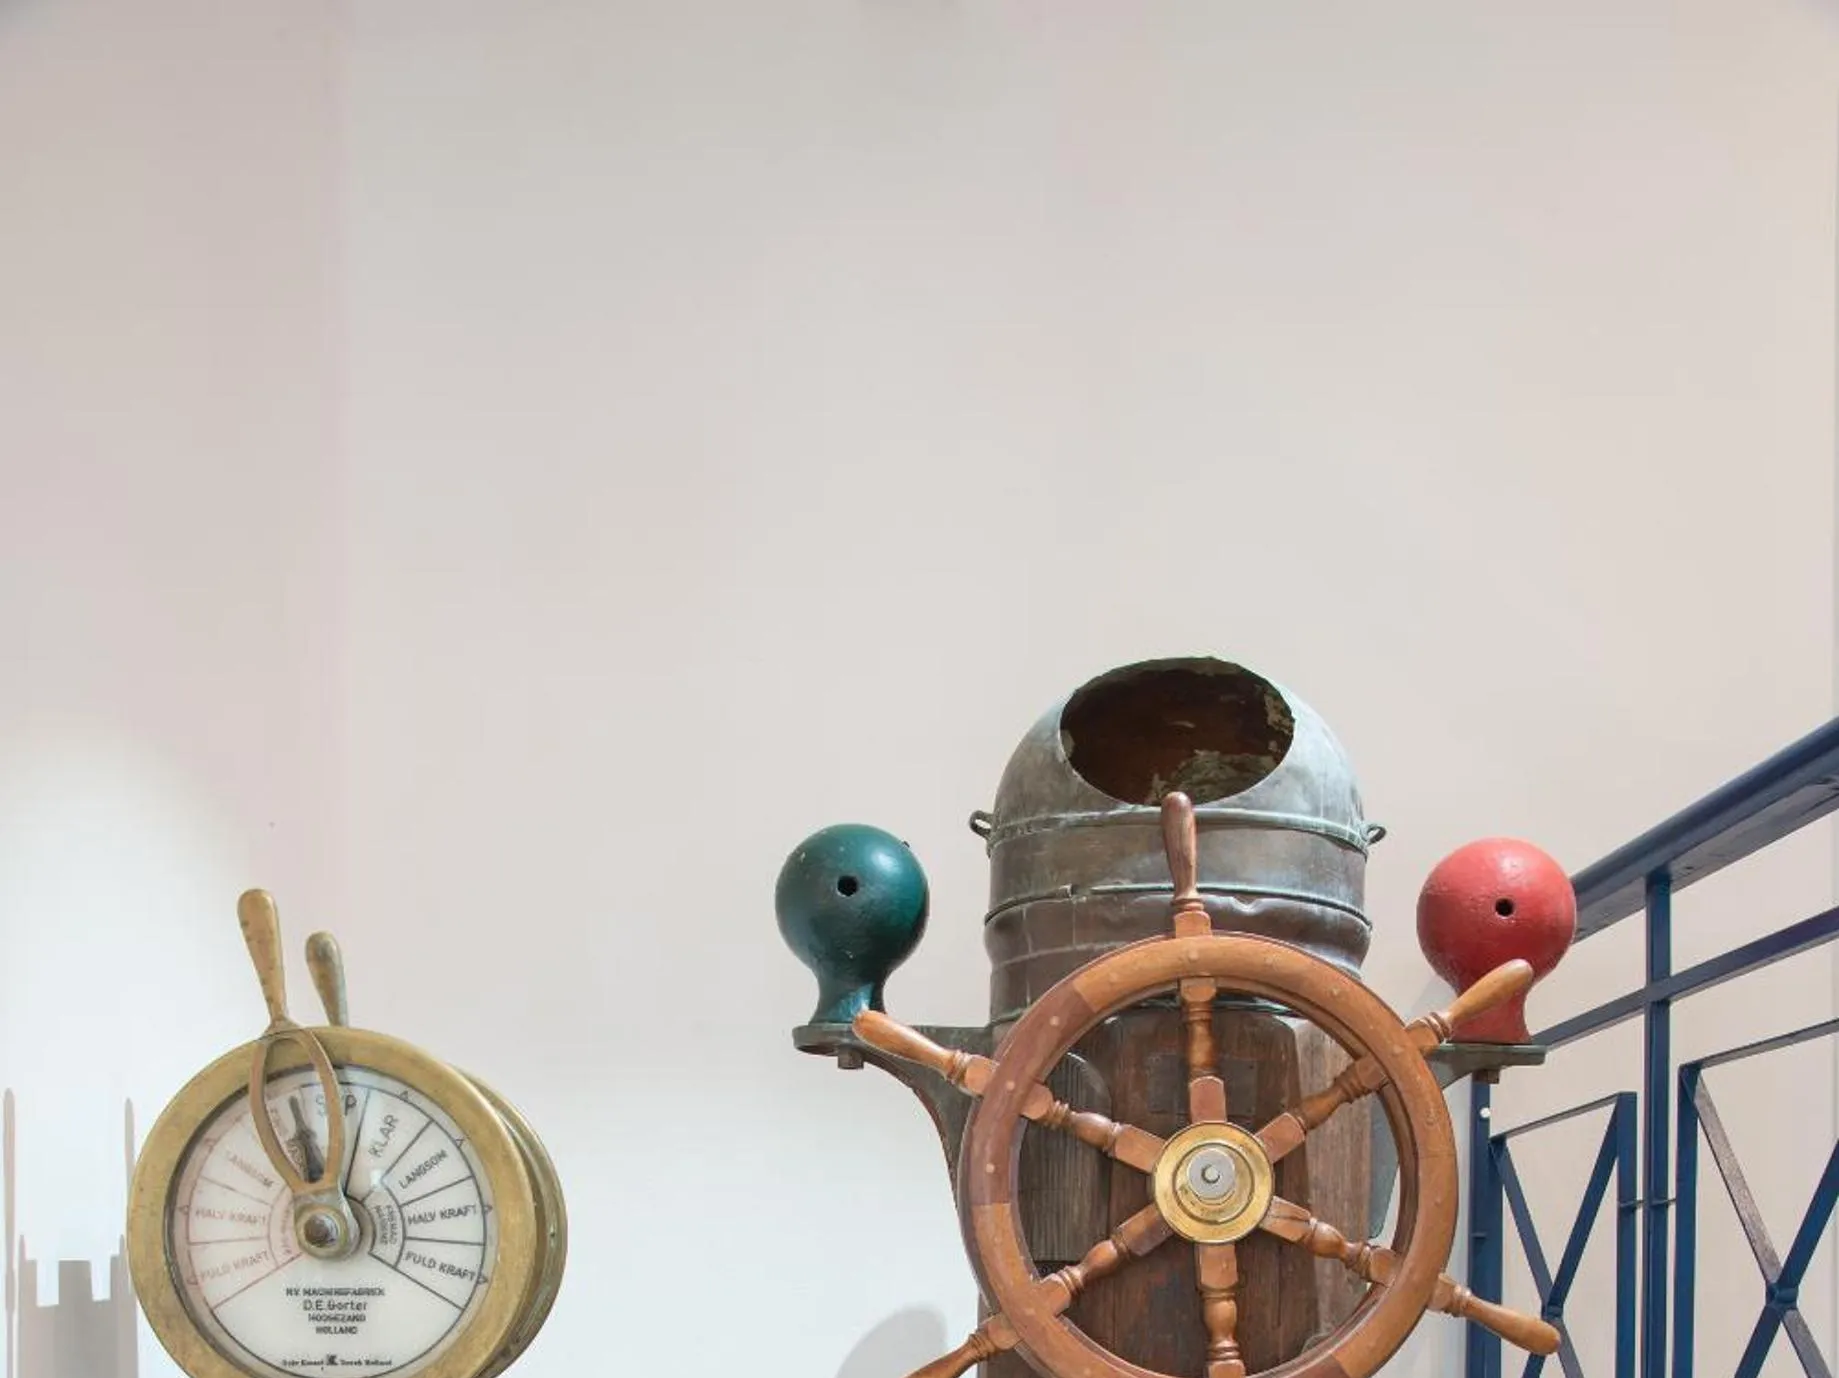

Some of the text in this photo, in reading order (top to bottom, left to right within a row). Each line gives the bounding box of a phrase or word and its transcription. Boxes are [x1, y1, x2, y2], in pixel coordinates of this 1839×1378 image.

[368, 1114, 398, 1158] KLAR
[398, 1149, 448, 1190] LANGSOM
[407, 1204, 477, 1225] HALV KRAFT
[404, 1251, 476, 1282] FULD KRAFT
[315, 1325, 358, 1335] HOLLAND
